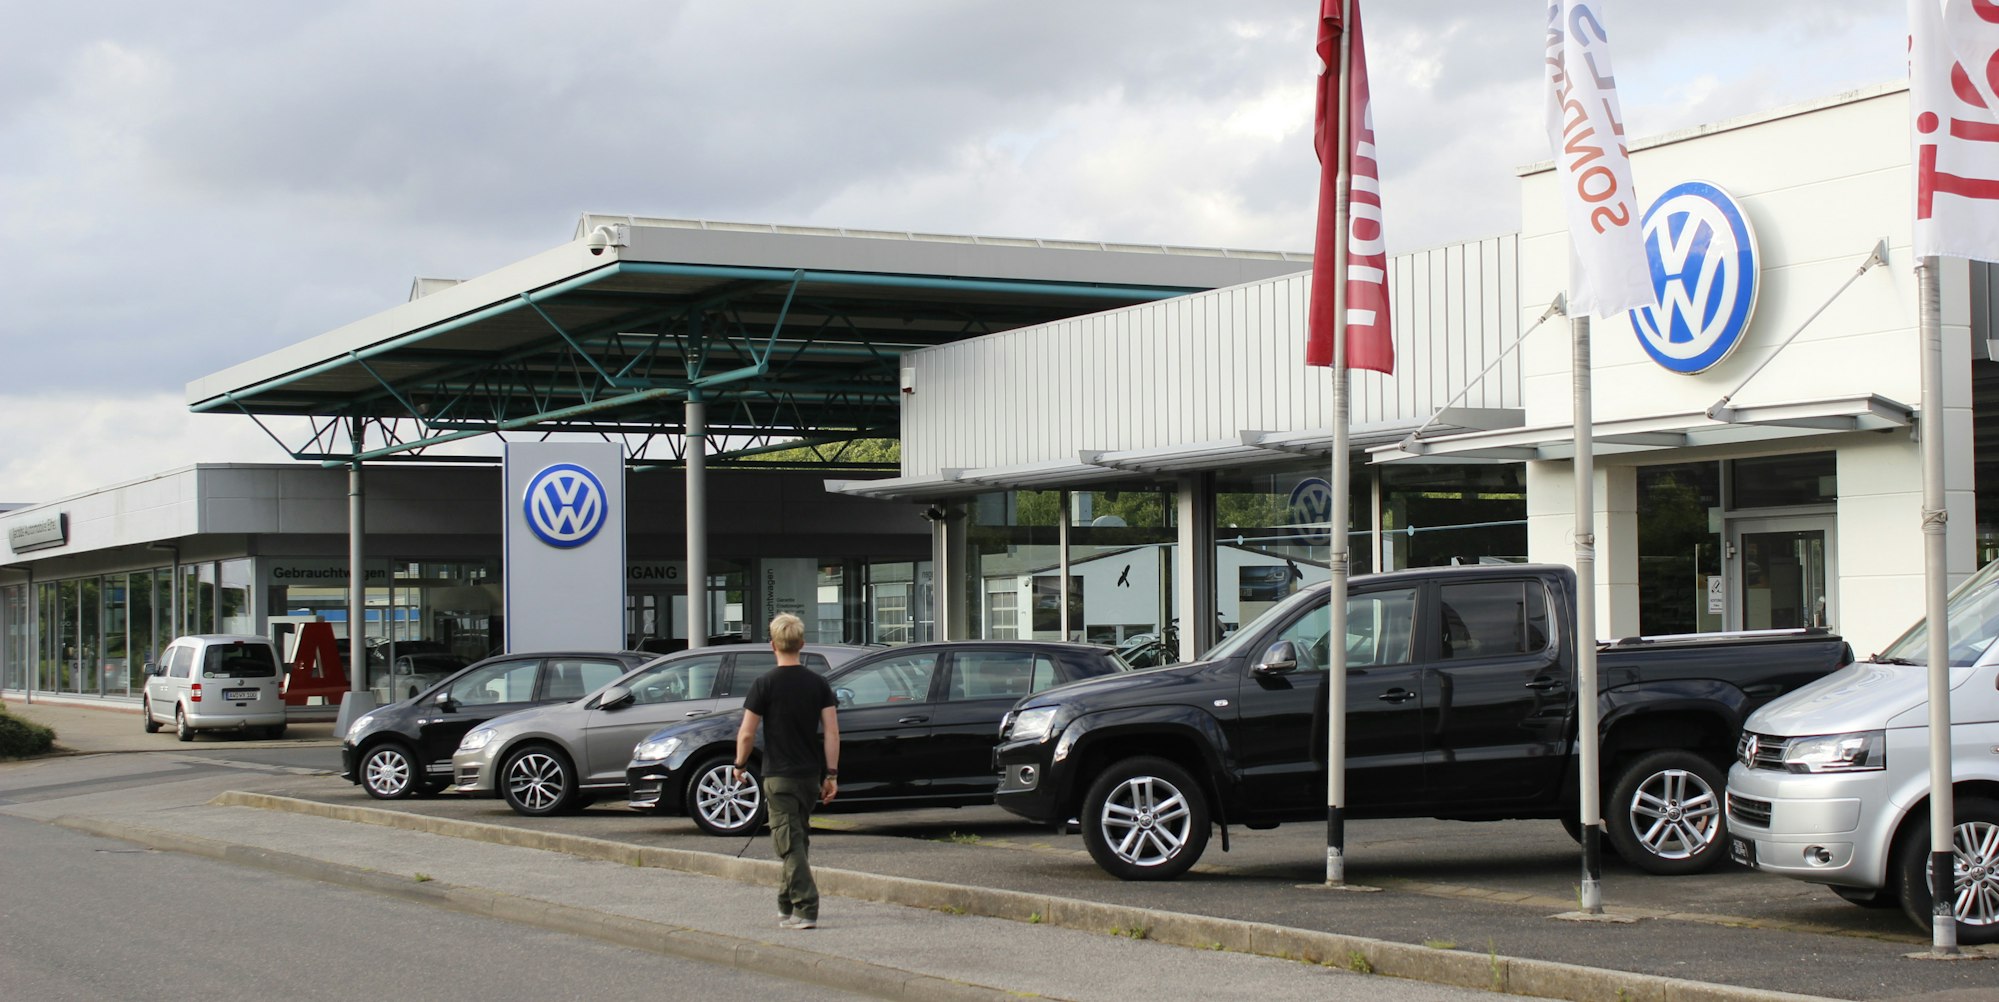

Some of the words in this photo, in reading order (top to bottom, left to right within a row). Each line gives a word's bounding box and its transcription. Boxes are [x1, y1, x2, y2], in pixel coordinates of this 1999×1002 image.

[1640, 195, 1738, 359] VW
[531, 469, 602, 541] VW
[273, 567, 386, 581] Gebrauchtwgen
